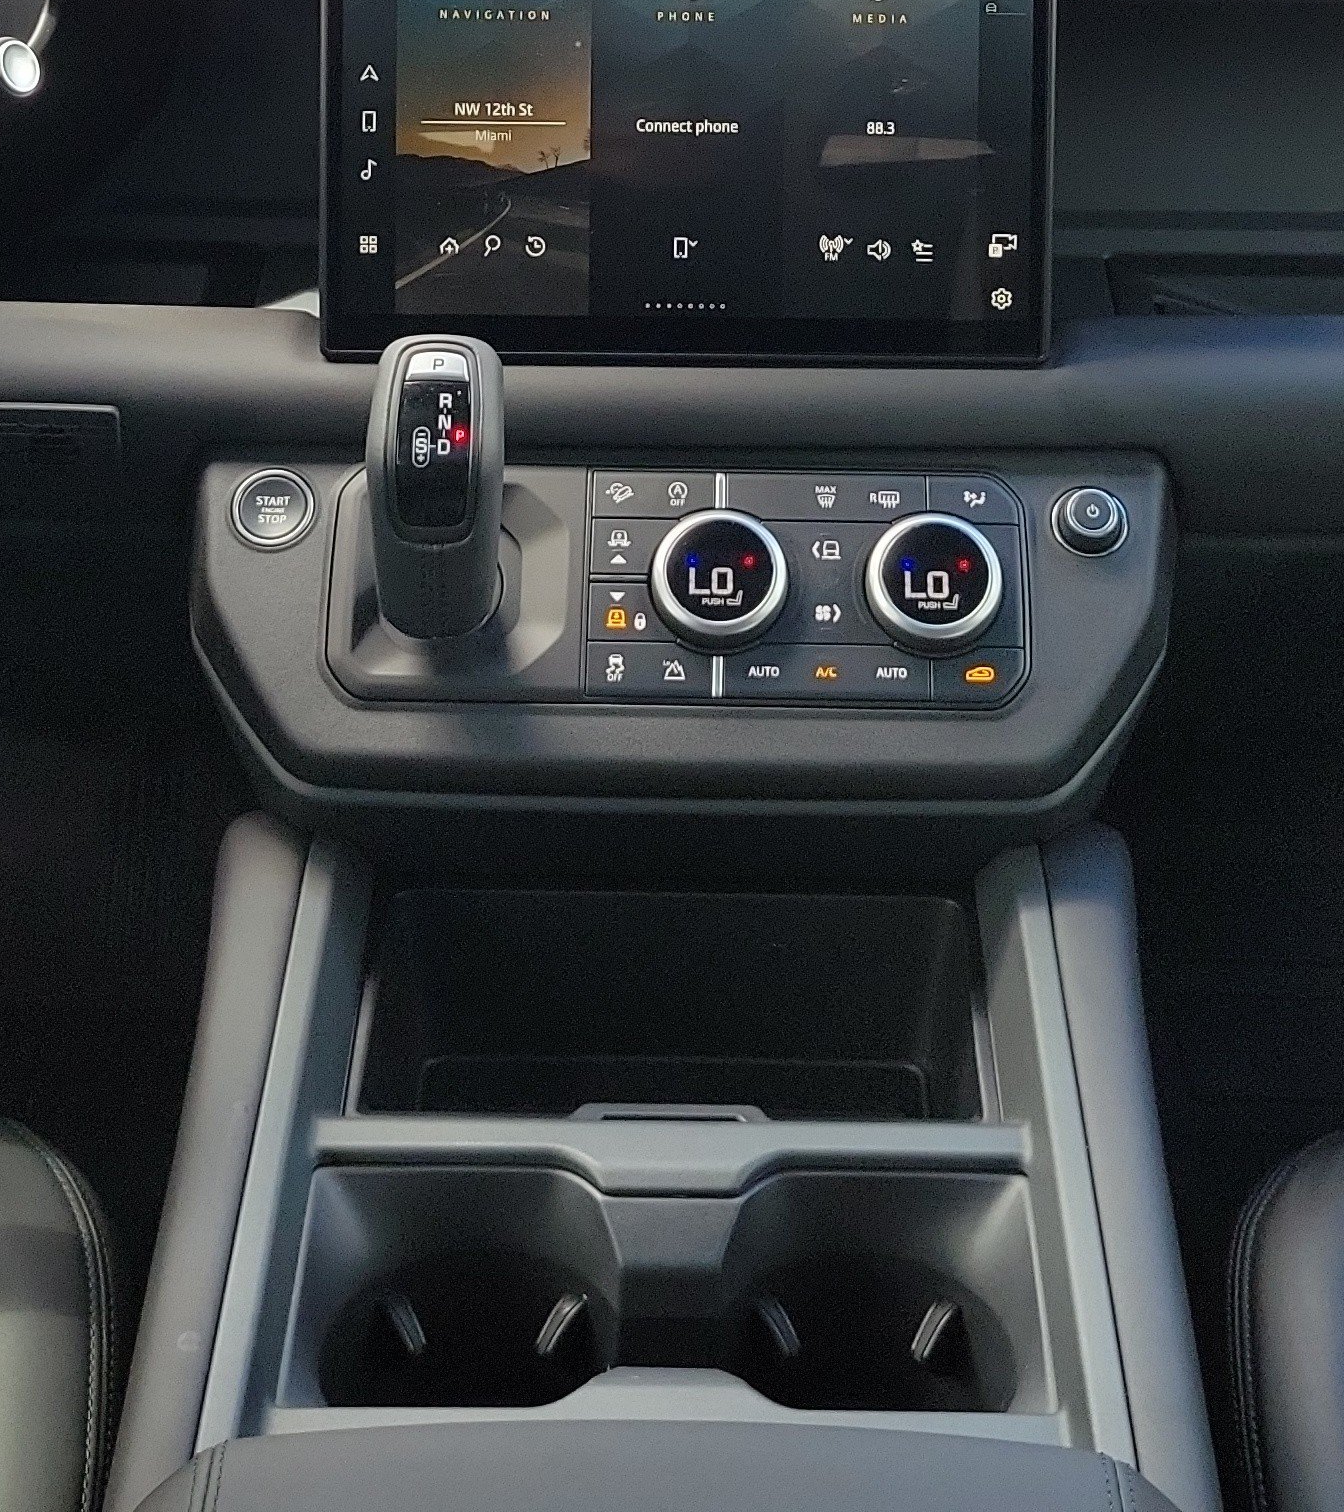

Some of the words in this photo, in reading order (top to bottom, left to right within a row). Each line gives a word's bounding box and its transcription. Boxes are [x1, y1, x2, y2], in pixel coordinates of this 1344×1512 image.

[439, 9, 551, 21] NAVIGATION
[657, 12, 716, 23] PHONE
[853, 13, 907, 24] MEDIA
[454, 103, 480, 117] NW
[485, 103, 515, 117] 12th
[518, 103, 534, 117] St
[636, 118, 692, 134] Connect
[696, 118, 739, 138] phone
[867, 122, 895, 135] 88.3
[475, 129, 512, 142] Miami
[825, 252, 838, 261] FM
[433, 358, 444, 370] P
[439, 393, 453, 408] R
[438, 415, 451, 430] N
[416, 438, 427, 453] S
[437, 439, 451, 455] D
[815, 485, 837, 494] MAX
[256, 496, 291, 506] START
[670, 498, 686, 506] OFF
[870, 493, 877, 503] R
[258, 514, 287, 523] STOP
[689, 567, 734, 595] LO
[904, 571, 949, 599] LO
[702, 598, 725, 606] PUSH
[918, 602, 941, 610] PUSH
[607, 673, 623, 682] OFF
[748, 666, 780, 678] AUTO
[815, 667, 838, 678] A/C
[876, 667, 908, 679] AUTO
